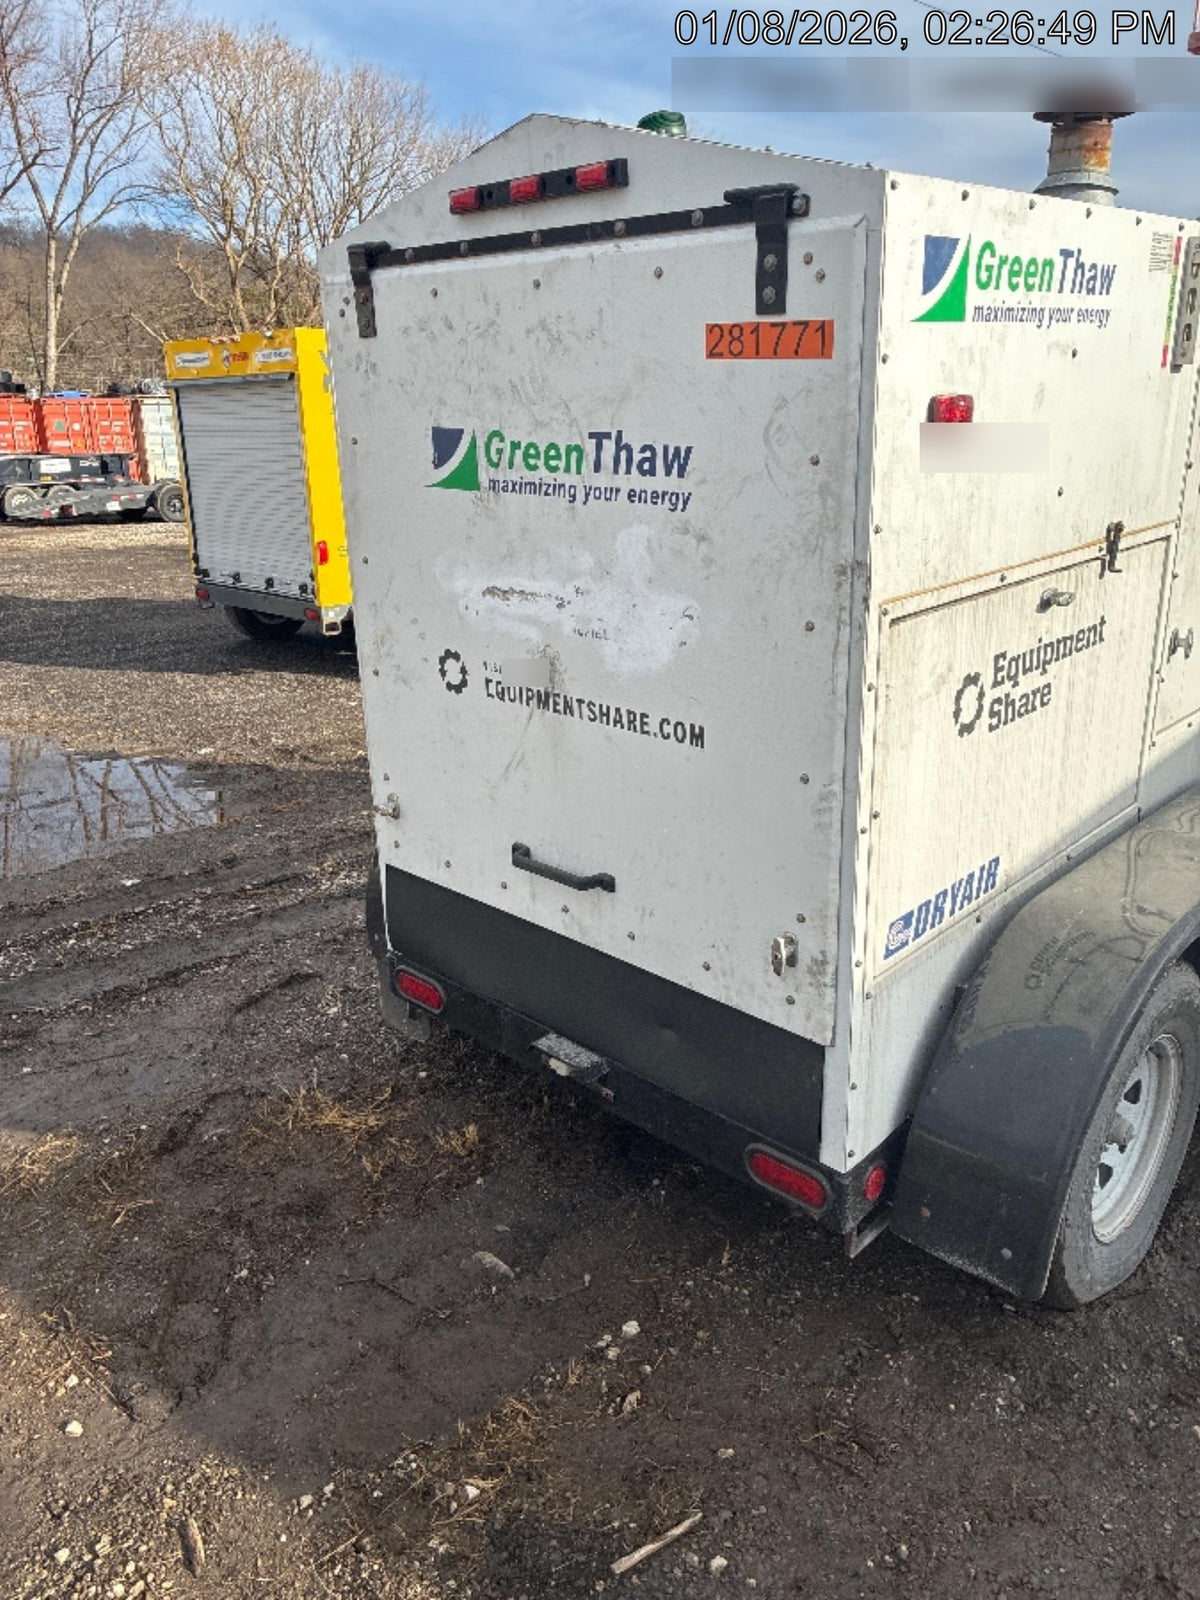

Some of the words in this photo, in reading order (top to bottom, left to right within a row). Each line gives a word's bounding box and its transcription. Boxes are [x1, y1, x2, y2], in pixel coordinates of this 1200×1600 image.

[975, 240, 1118, 296] GreenThaw
[708, 319, 827, 358] 281771
[972, 300, 1045, 329] maximizing
[1046, 306, 1075, 329] your
[1076, 308, 1112, 330] energy
[484, 429, 694, 479] GreenThaw
[488, 476, 577, 503] maximizing
[582, 484, 621, 505] your
[627, 487, 693, 513] energy
[990, 615, 1107, 690] Equipment
[484, 677, 705, 749] EQUIPMENTSHARE.COM
[988, 682, 1052, 733] Share
[912, 855, 1000, 943] DRYAIR
